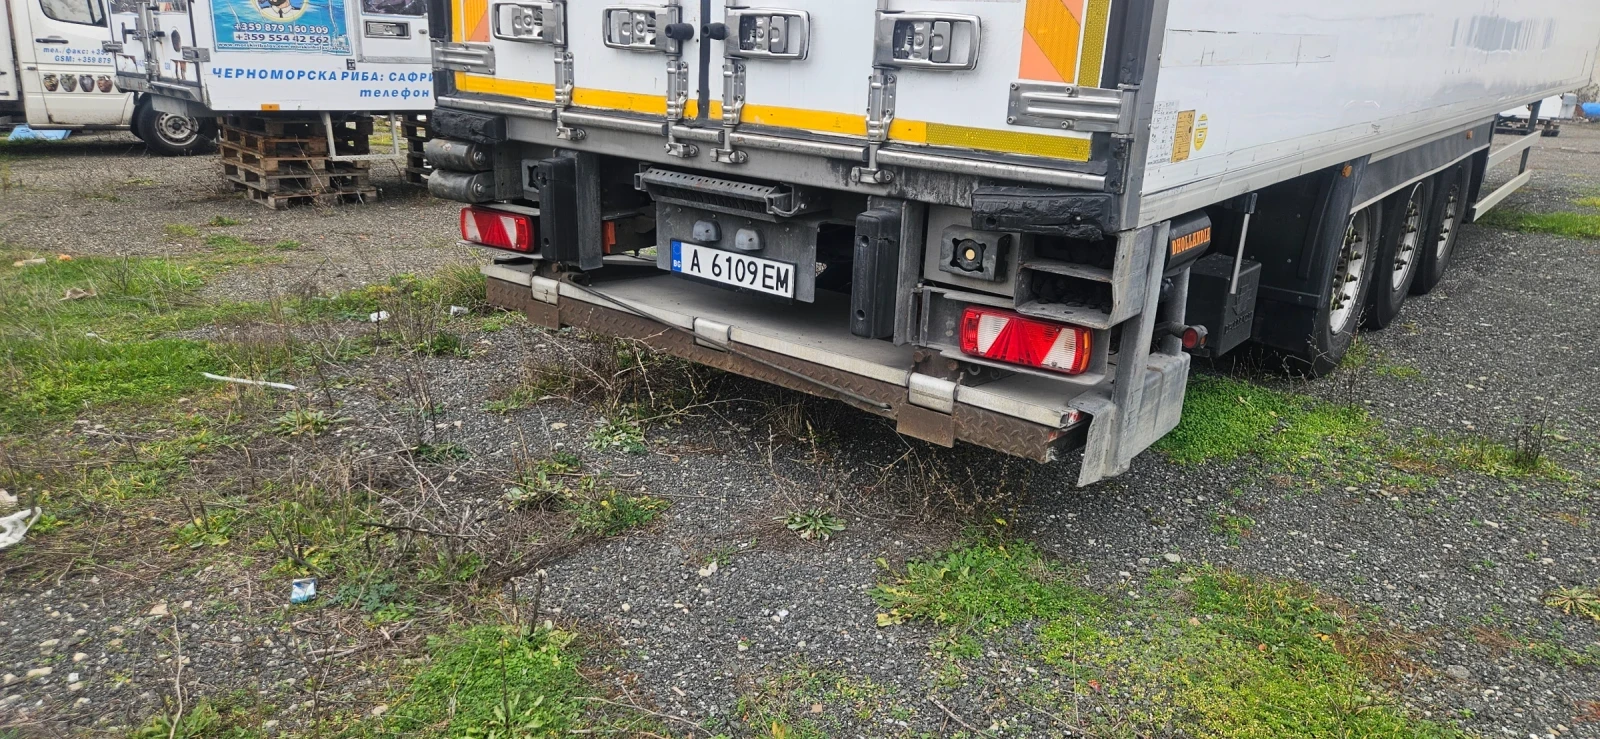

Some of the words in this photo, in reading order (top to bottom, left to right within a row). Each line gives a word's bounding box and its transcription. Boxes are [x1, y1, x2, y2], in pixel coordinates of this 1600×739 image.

[234, 23, 261, 31] +359
[265, 23, 284, 32] 879
[288, 24, 306, 33] 160
[309, 25, 328, 34] 309
[235, 33, 265, 41] +359
[268, 34, 289, 42] 554
[292, 34, 305, 43] 42
[309, 35, 329, 44] 562
[54, 55, 75, 63] GSM:
[212, 68, 337, 81] ЧЕРНОМОРСКА
[341, 71, 384, 82] РИБА:
[359, 87, 430, 100] телефон
[673, 259, 682, 268] BG
[690, 248, 702, 274] A
